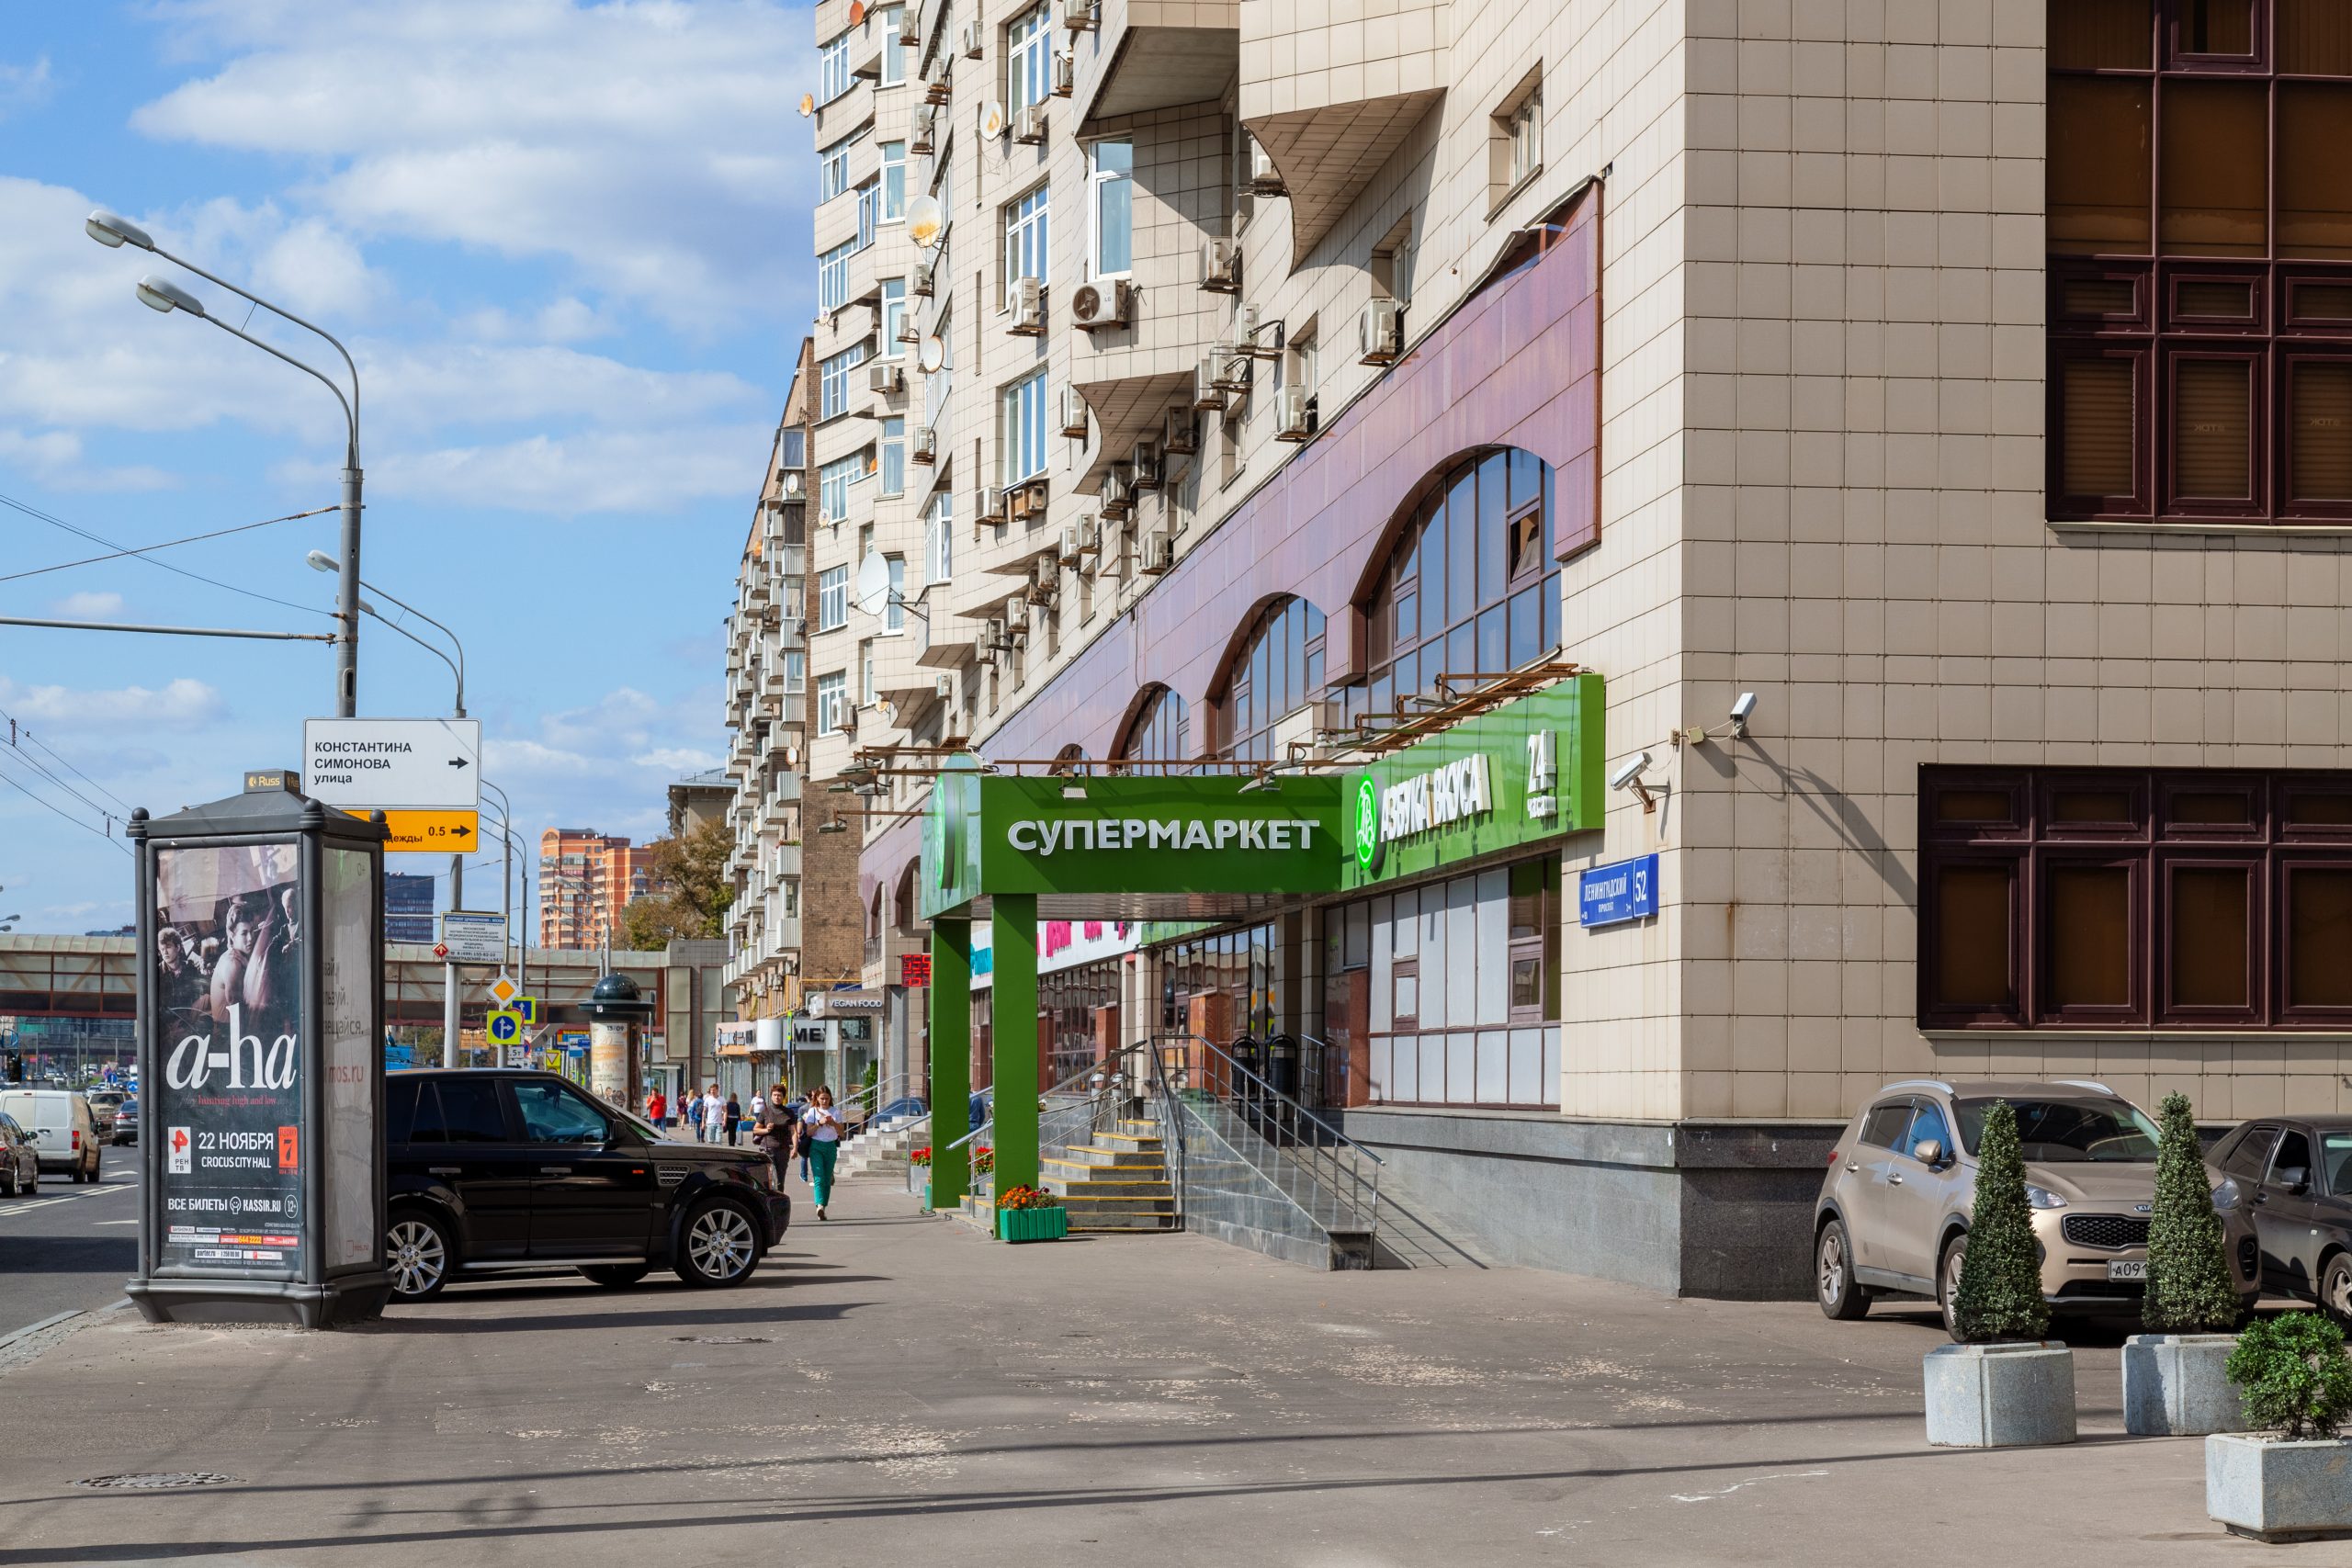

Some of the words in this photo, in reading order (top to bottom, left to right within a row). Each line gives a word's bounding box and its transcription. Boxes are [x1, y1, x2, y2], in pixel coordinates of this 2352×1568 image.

[314, 742, 413, 752] КОНСТАНТИНА
[314, 759, 391, 769] СИМОНОВА
[1528, 728, 1556, 795] 24
[258, 775, 280, 787] Russ
[314, 774, 353, 785] улица
[1379, 773, 1431, 843] АЗБУКА
[1433, 753, 1492, 826] ВКУСА
[427, 827, 446, 837] 0.5
[1007, 818, 1320, 856] СУПЕРМАРКЕТ
[1584, 873, 1627, 902] ЛЕНИНГРАДСКИЙ
[1635, 870, 1647, 902] 52
[829, 999, 857, 1008] VEGAN
[858, 999, 883, 1008] FOOD
[165, 1002, 297, 1090] a-ha
[198, 1095, 230, 1108] hunting
[232, 1095, 249, 1108] high
[250, 1095, 265, 1104] and
[265, 1095, 277, 1104] low
[198, 1132, 215, 1150] 22
[220, 1132, 274, 1150] НОЯБРЯ
[283, 1139, 292, 1161] 7
[201, 1156, 234, 1168] CROCUS
[235, 1156, 252, 1168] CITY
[253, 1156, 272, 1168] HALL
[168, 1198, 187, 1211] ВСЕ
[188, 1198, 228, 1211] БИЛЕТЫ
[243, 1199, 281, 1213] KASSIR.RU
[287, 1200, 297, 1213] 12+
